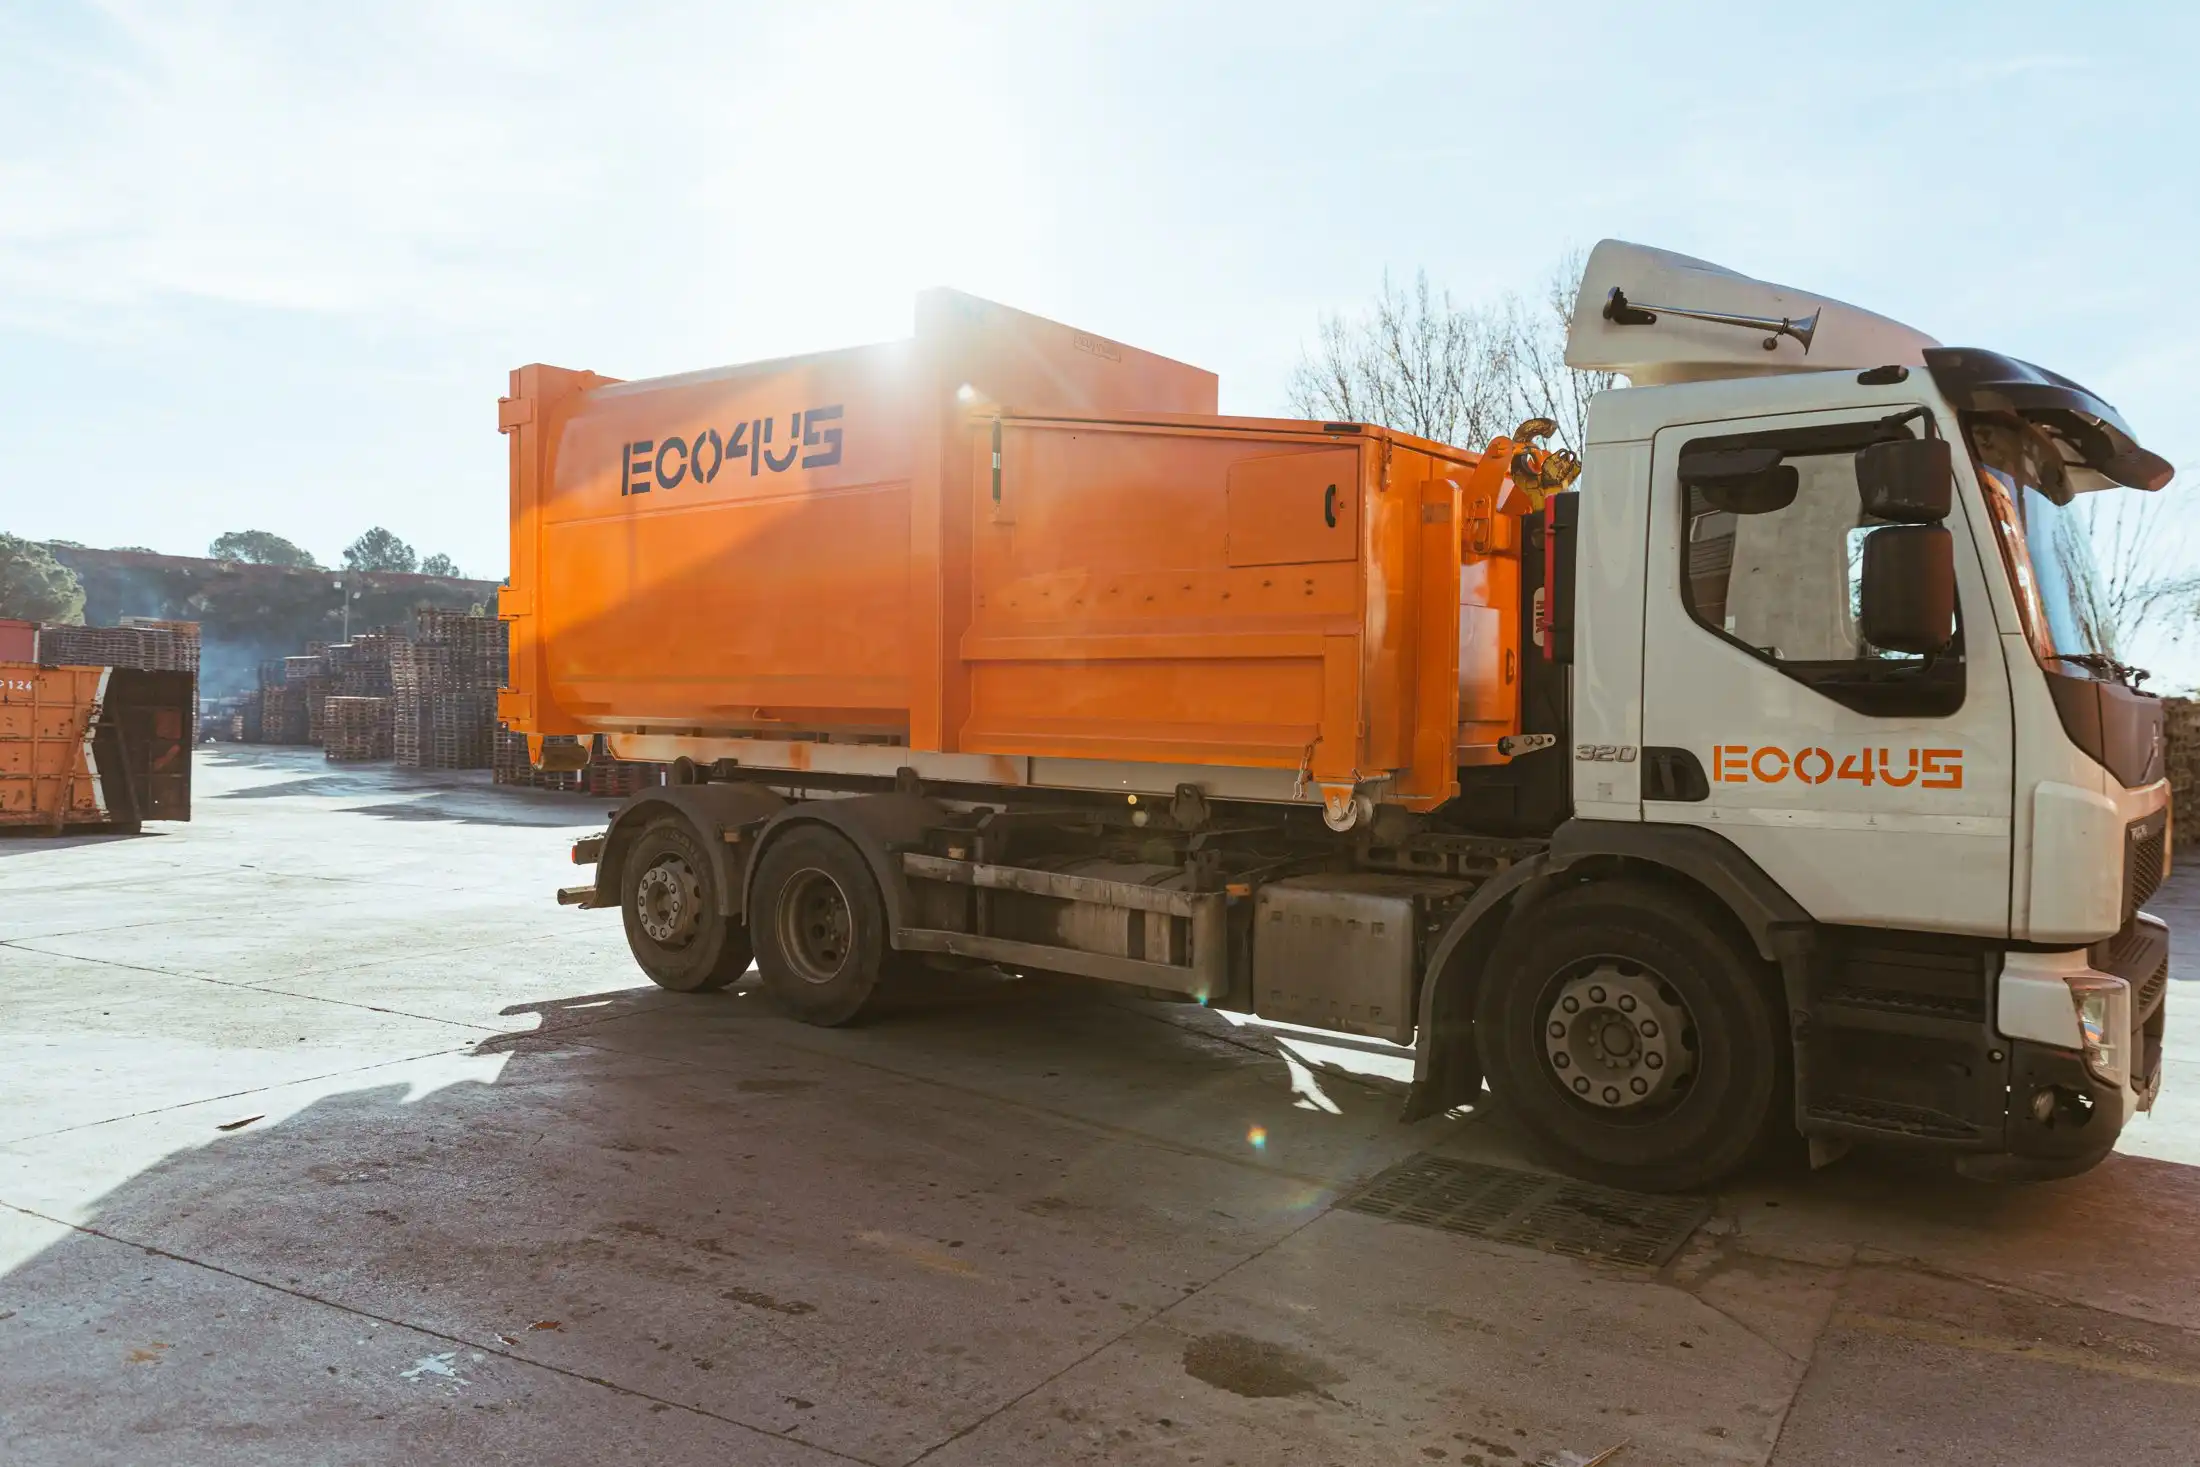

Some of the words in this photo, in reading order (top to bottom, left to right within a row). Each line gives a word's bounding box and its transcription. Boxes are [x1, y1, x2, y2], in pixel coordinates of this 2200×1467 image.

[621, 404, 844, 497] ECO4US
[1575, 744, 1638, 763] 320
[1713, 745, 1963, 790] ECO4US
